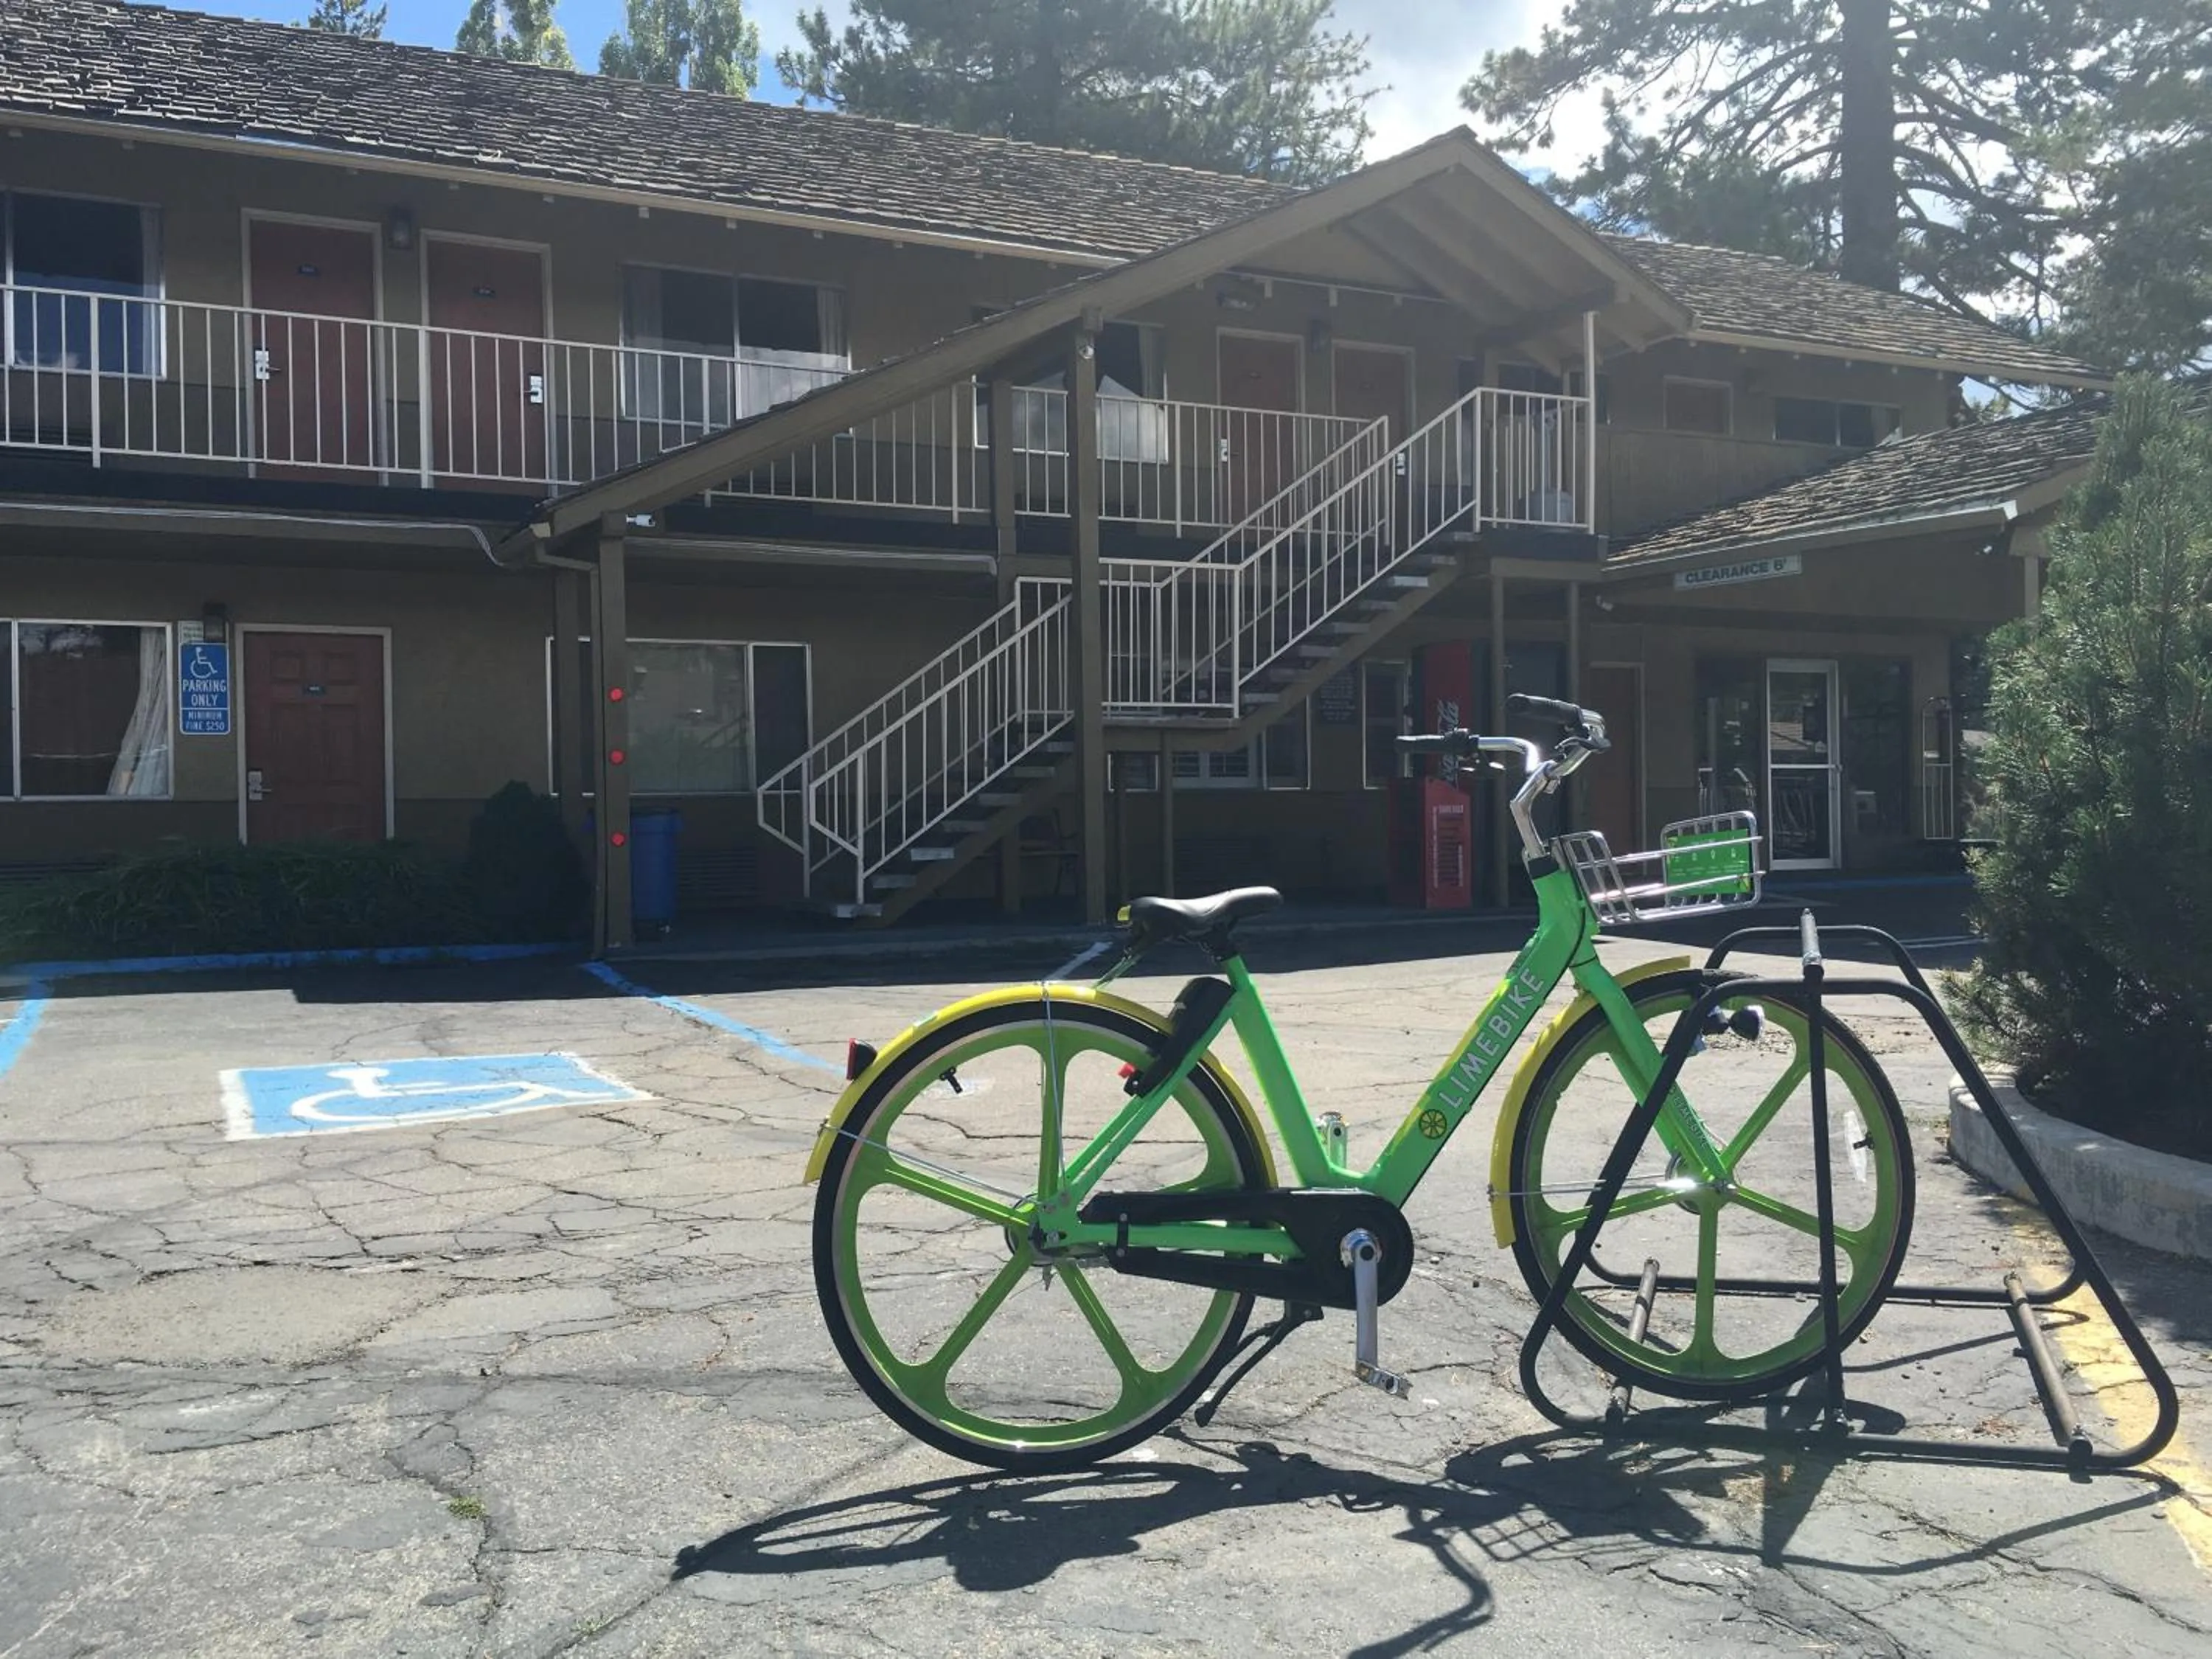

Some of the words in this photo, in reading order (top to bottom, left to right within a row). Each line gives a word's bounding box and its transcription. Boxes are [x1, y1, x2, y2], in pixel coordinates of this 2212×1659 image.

[1686, 562, 1769, 583] CLEARANCE
[182, 679, 226, 692] PARKING
[191, 694, 218, 706] ONLY
[1439, 968, 1545, 1108] LIMEBIKE
